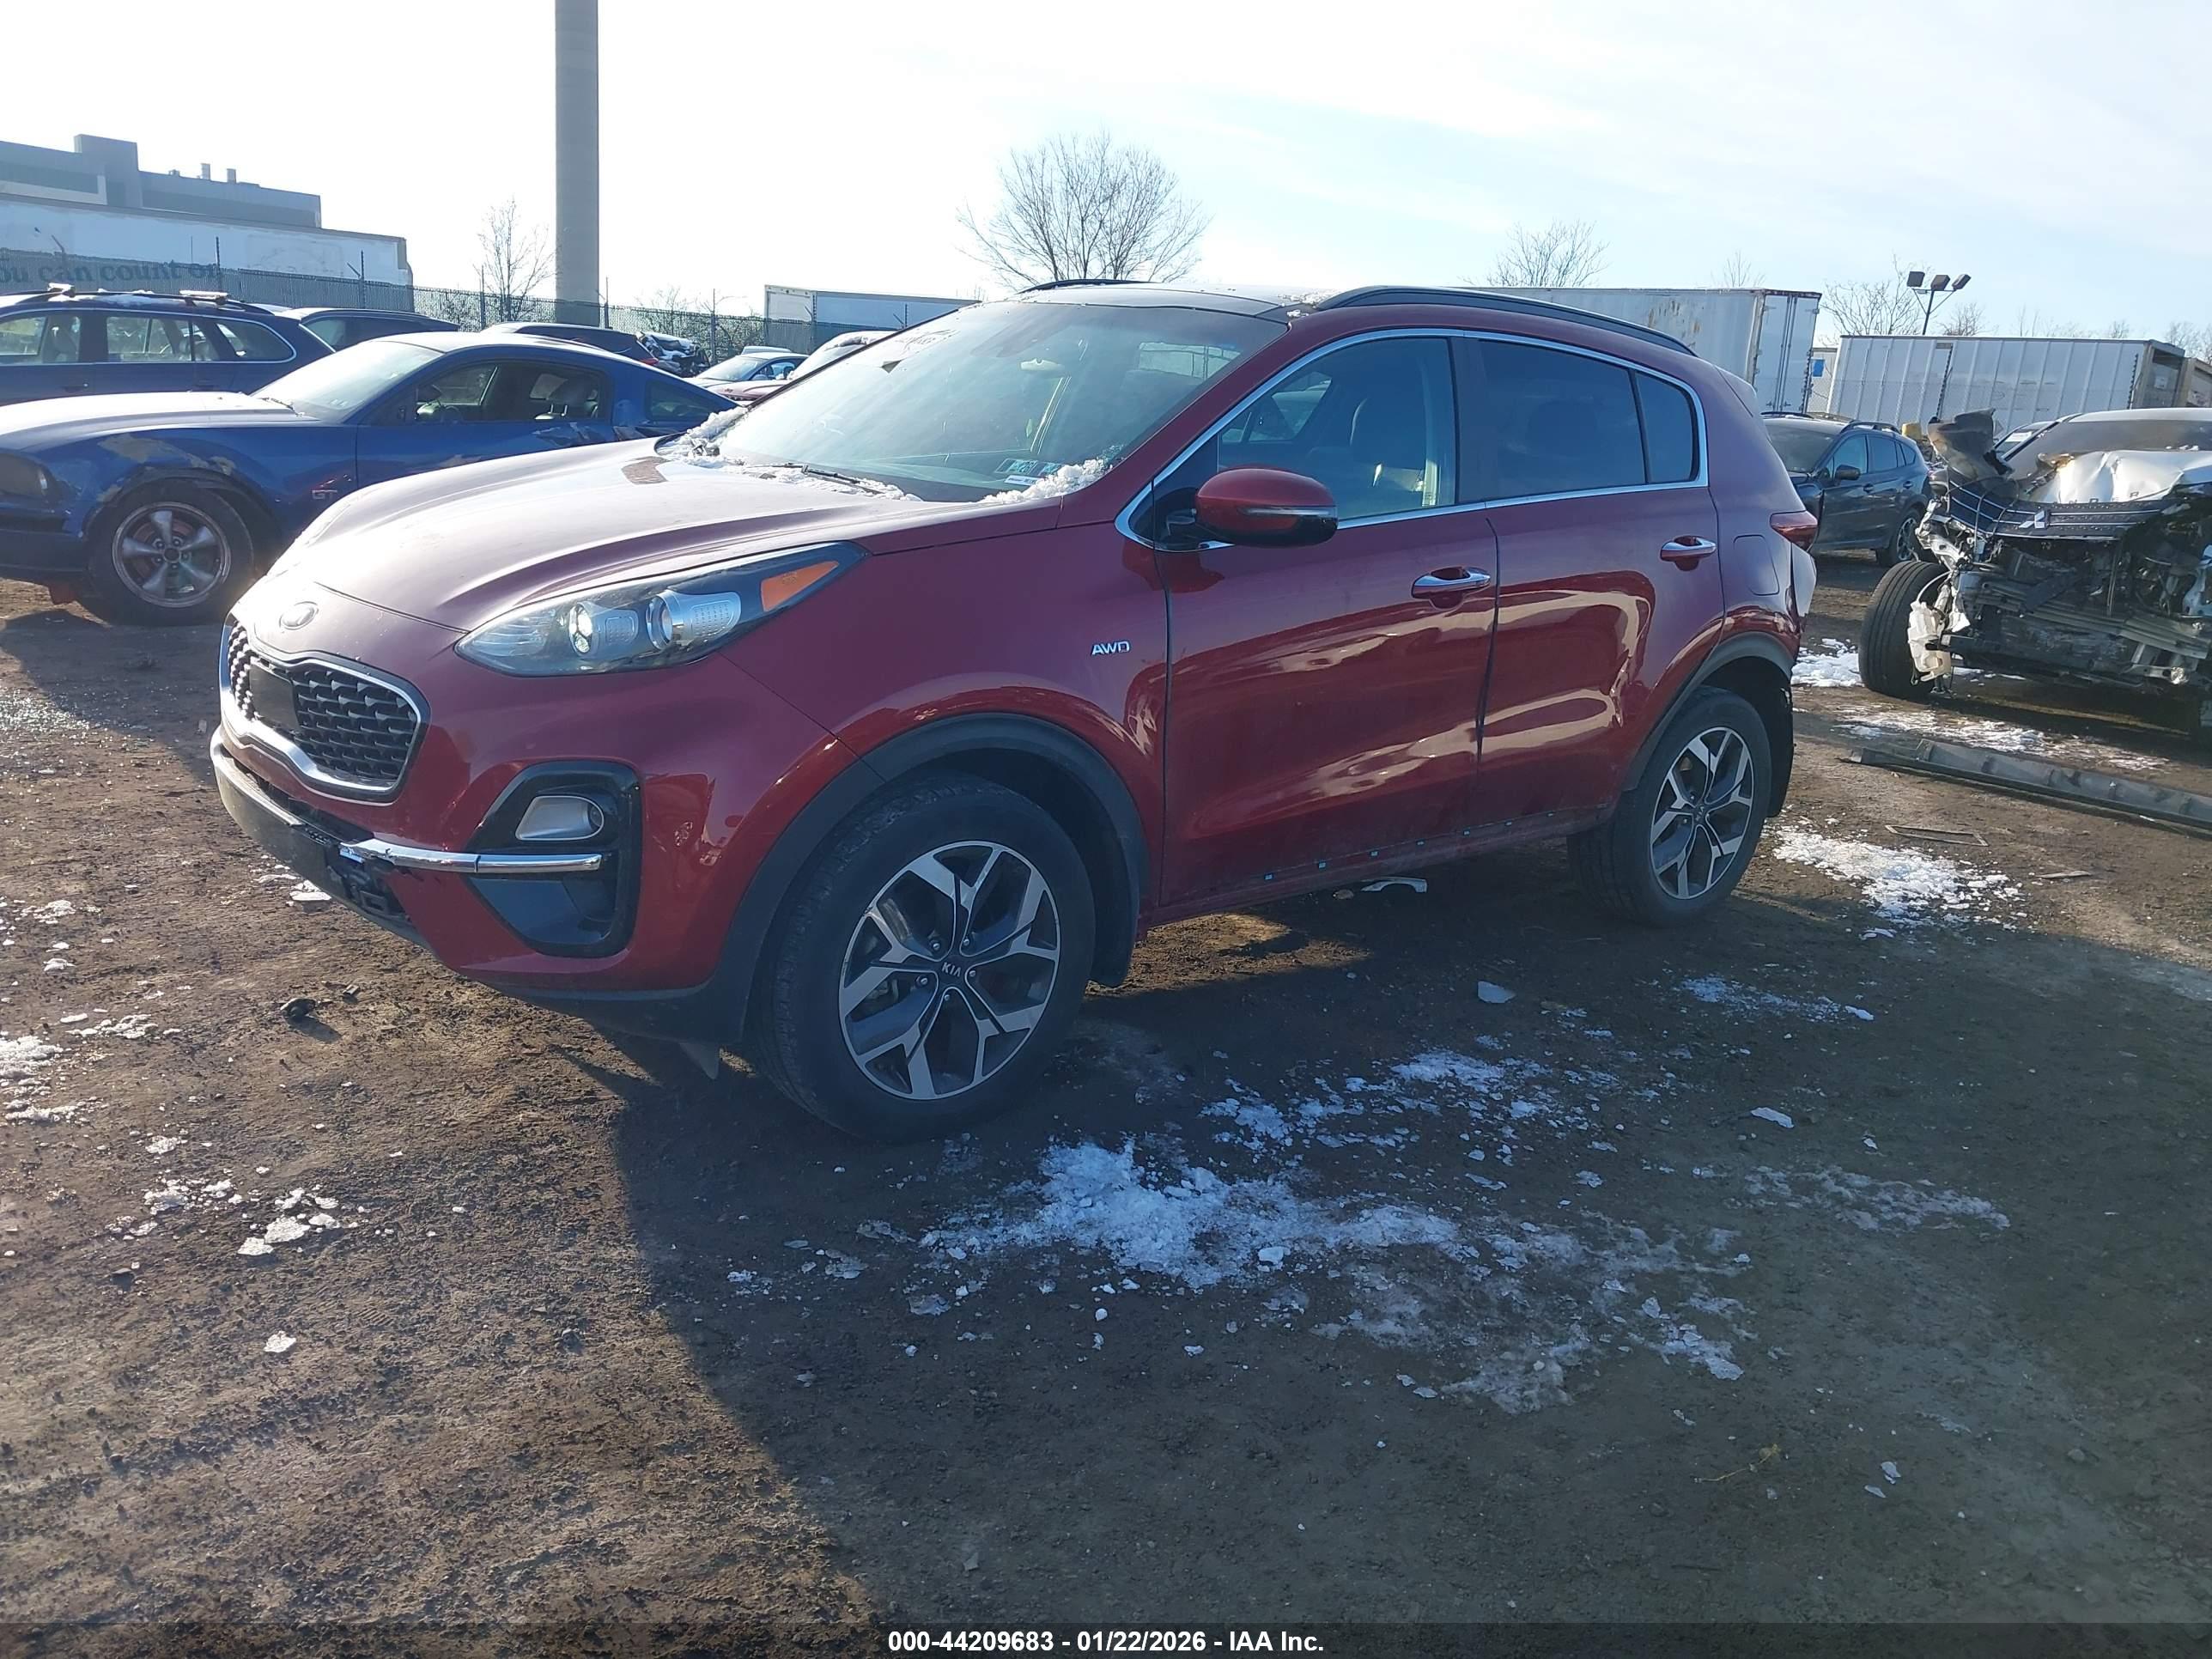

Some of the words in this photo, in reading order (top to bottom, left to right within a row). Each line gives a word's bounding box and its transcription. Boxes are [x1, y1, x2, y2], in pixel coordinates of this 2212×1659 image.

[38, 265, 94, 283] can
[100, 258, 181, 282] count
[312, 489, 337, 500] GT
[1091, 641, 1131, 655] AWD
[941, 962, 962, 977] KIA
